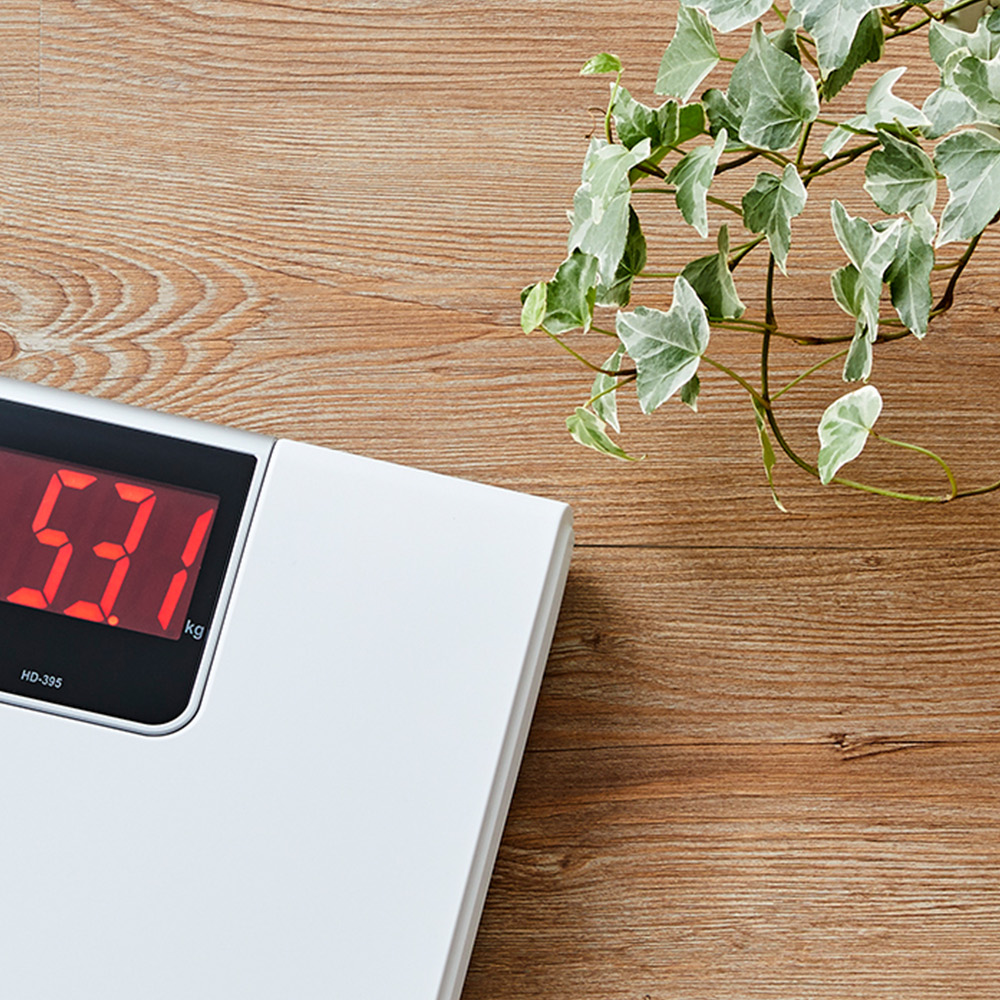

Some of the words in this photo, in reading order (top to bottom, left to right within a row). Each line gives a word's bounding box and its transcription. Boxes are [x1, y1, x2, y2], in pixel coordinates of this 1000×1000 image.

[6, 468, 214, 630] 53.1
[184, 619, 205, 640] kg
[20, 669, 63, 689] HD-395
